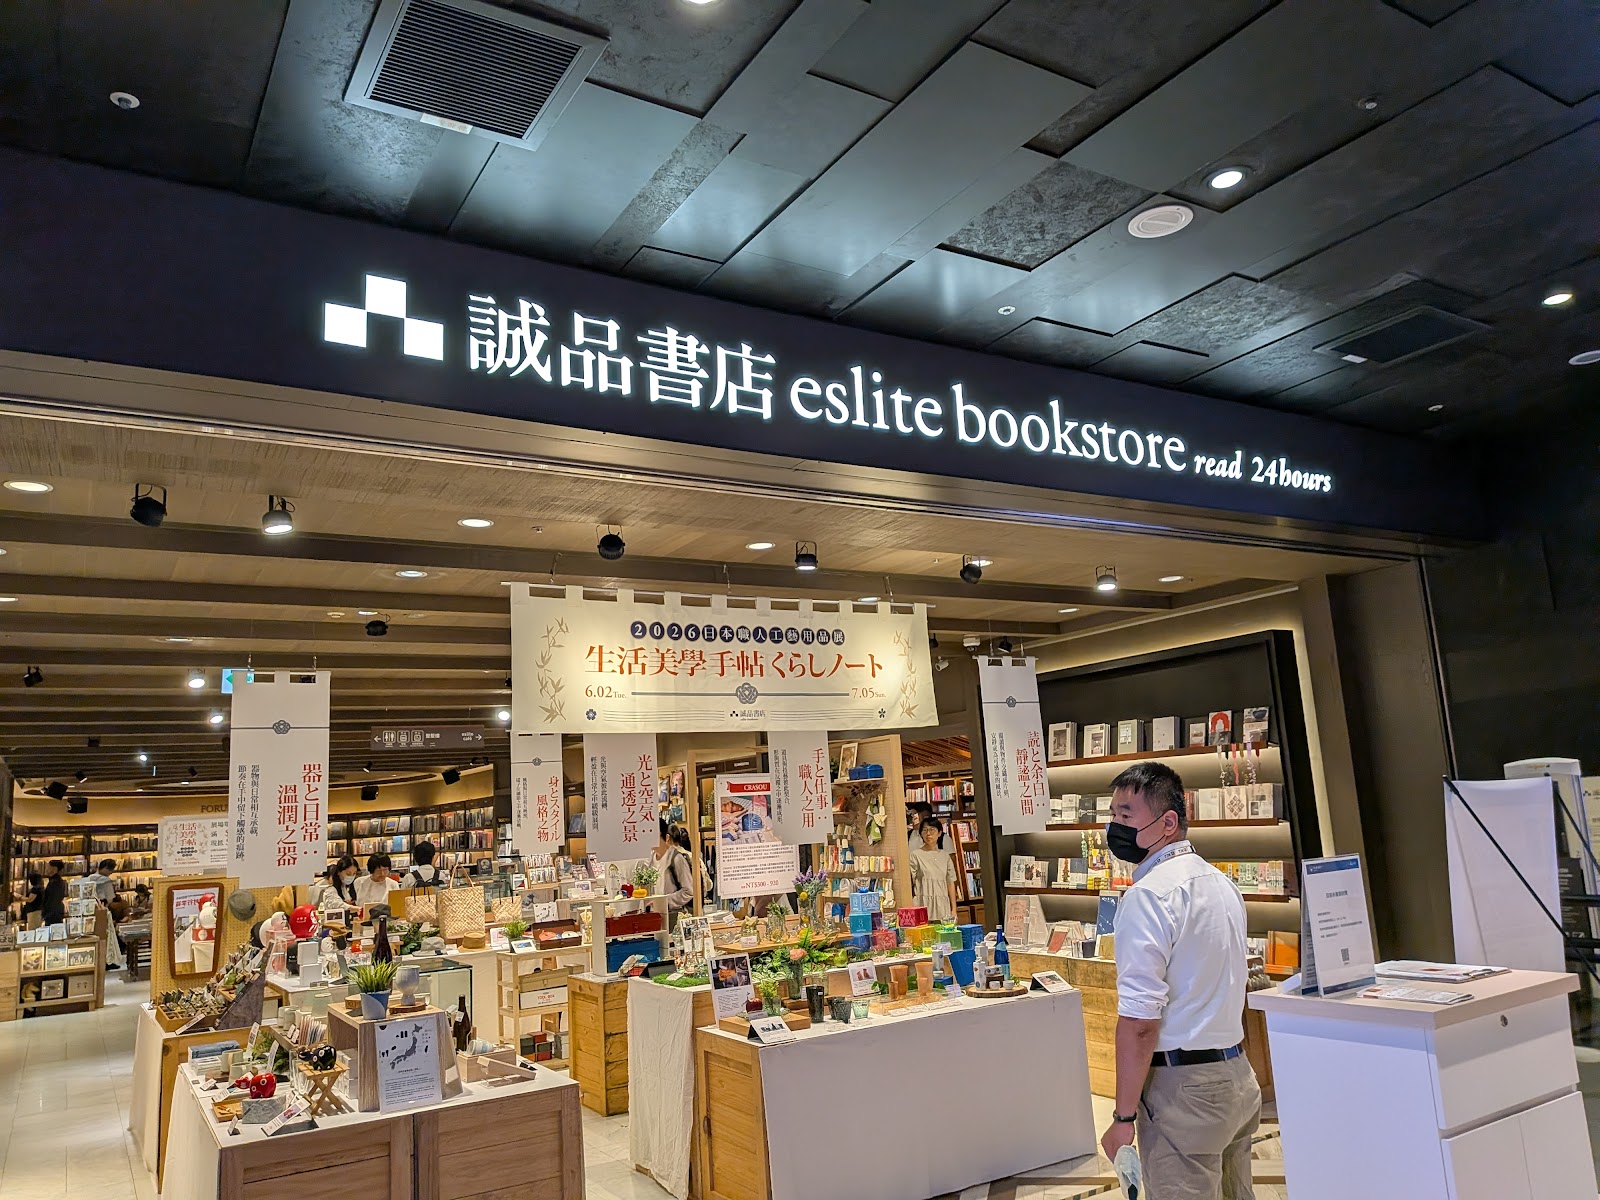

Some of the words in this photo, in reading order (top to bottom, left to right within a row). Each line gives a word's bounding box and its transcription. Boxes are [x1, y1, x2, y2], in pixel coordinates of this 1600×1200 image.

[467, 293, 777, 420] 誠品書店
[789, 365, 944, 438] eslite
[951, 383, 1187, 472] bookstore
[1193, 450, 1243, 480] read
[1250, 456, 1332, 493] 24hours
[585, 645, 883, 680] 生活美學手帖くらしノート
[631, 621, 845, 645] 2026日本職人工藝用品展
[200, 804, 228, 813] FORU
[620, 772, 638, 843] 通透之景
[798, 763, 814, 829] 職人之用
[1015, 747, 1035, 816] 靜謐之間
[276, 784, 299, 867] 溫潤之器
[536, 794, 549, 842] 風格之物
